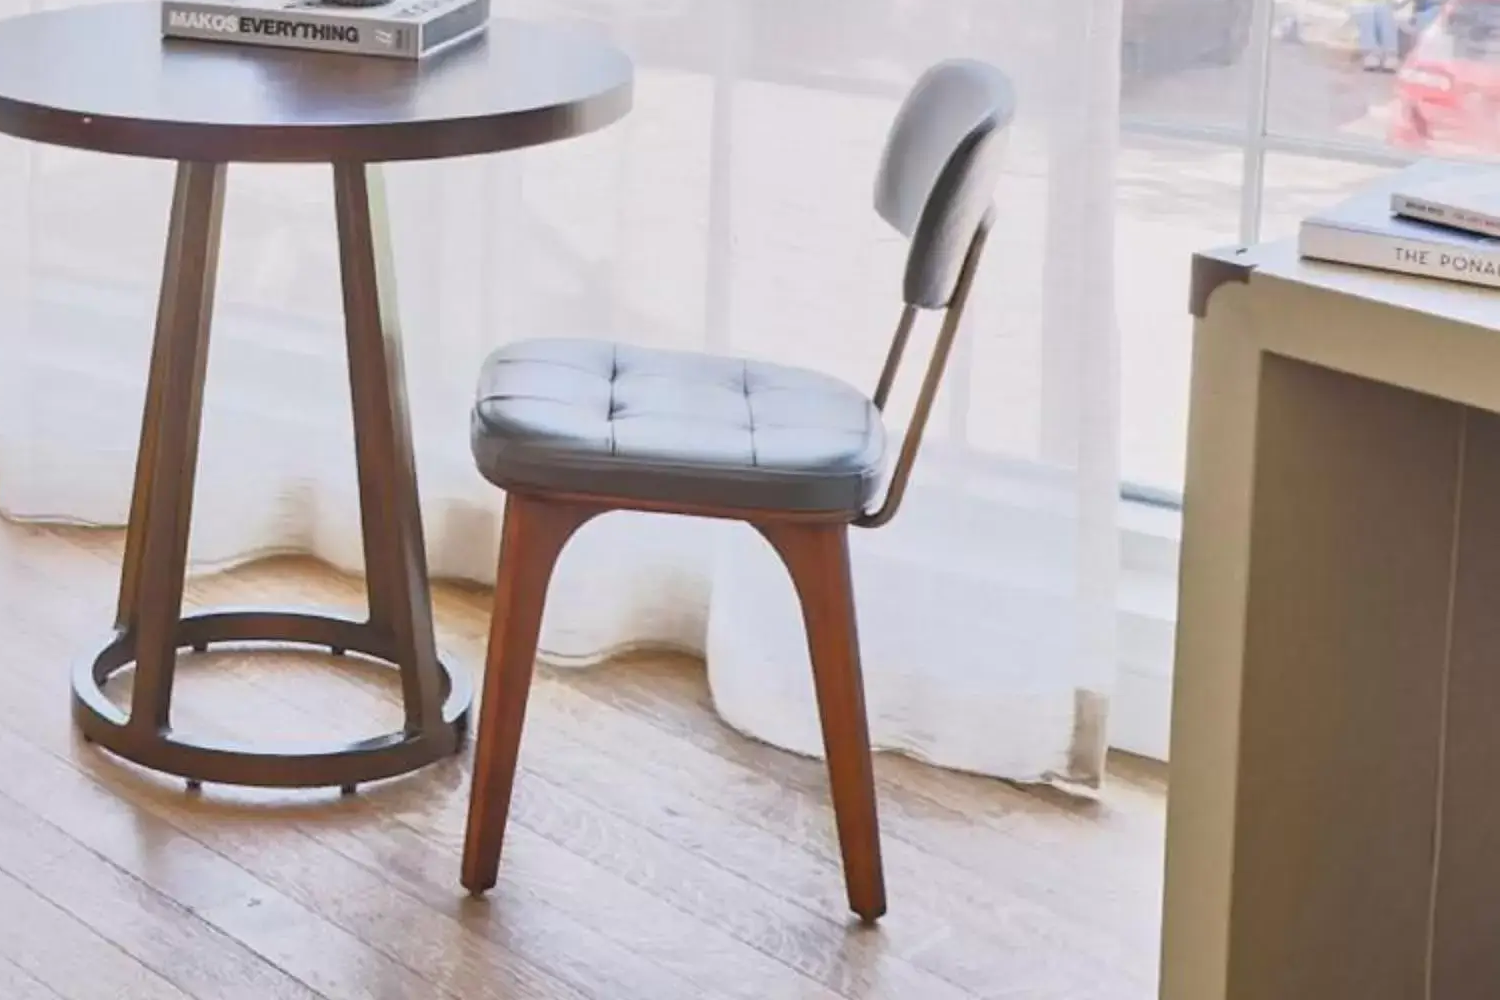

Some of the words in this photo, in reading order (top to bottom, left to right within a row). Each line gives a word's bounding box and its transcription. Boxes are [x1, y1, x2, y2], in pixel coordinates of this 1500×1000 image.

[169, 10, 238, 33] MAKOS
[239, 16, 360, 43] EVERYTHING
[1395, 247, 1430, 265] THE
